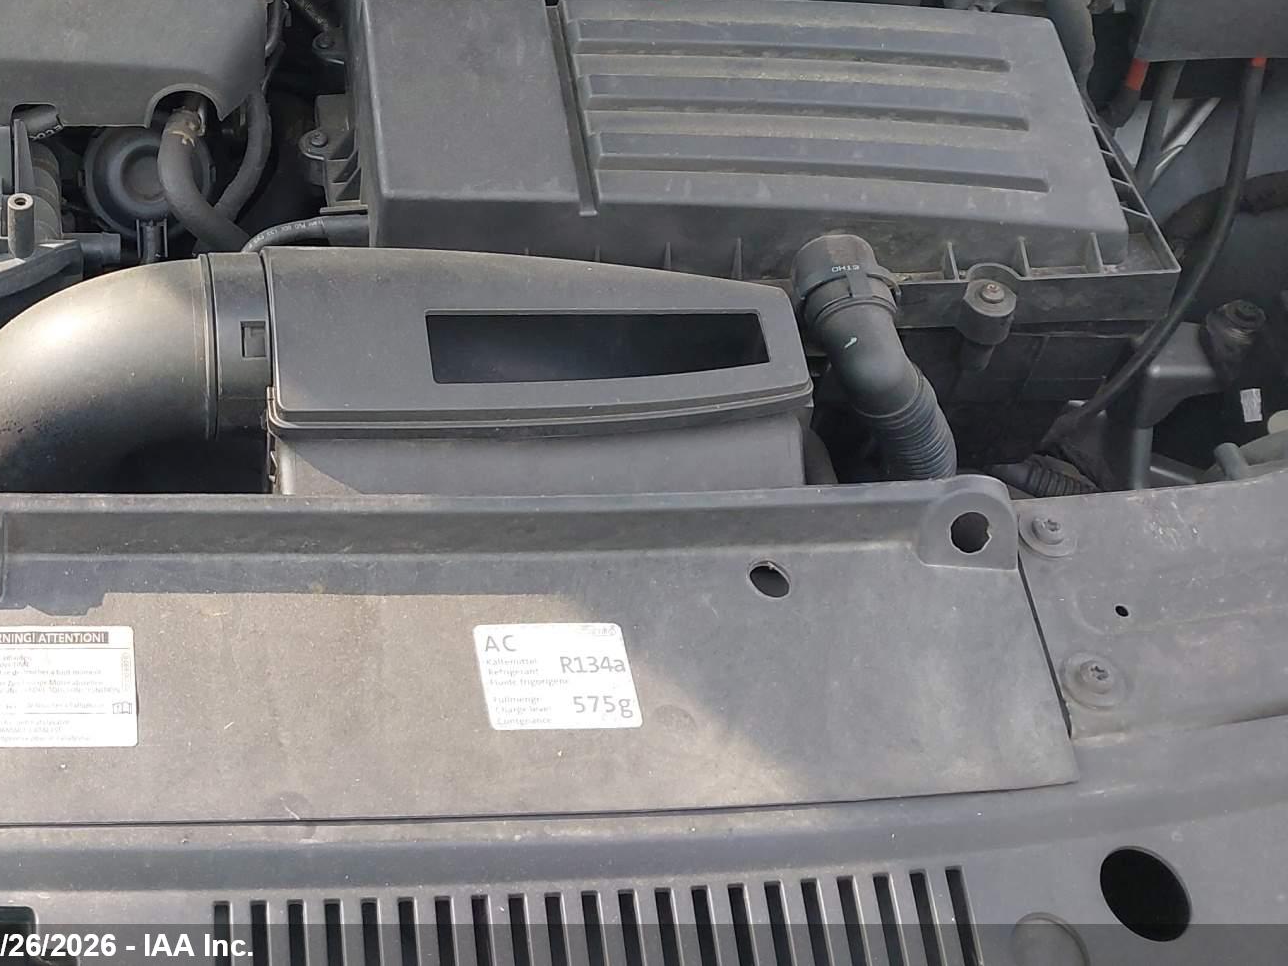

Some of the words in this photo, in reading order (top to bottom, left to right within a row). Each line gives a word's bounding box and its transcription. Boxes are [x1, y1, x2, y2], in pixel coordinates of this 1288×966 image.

[39, 631, 105, 644] ATTENTION!
[484, 634, 517, 652] AC
[560, 656, 626, 674] R134a
[573, 696, 634, 719] 575g
